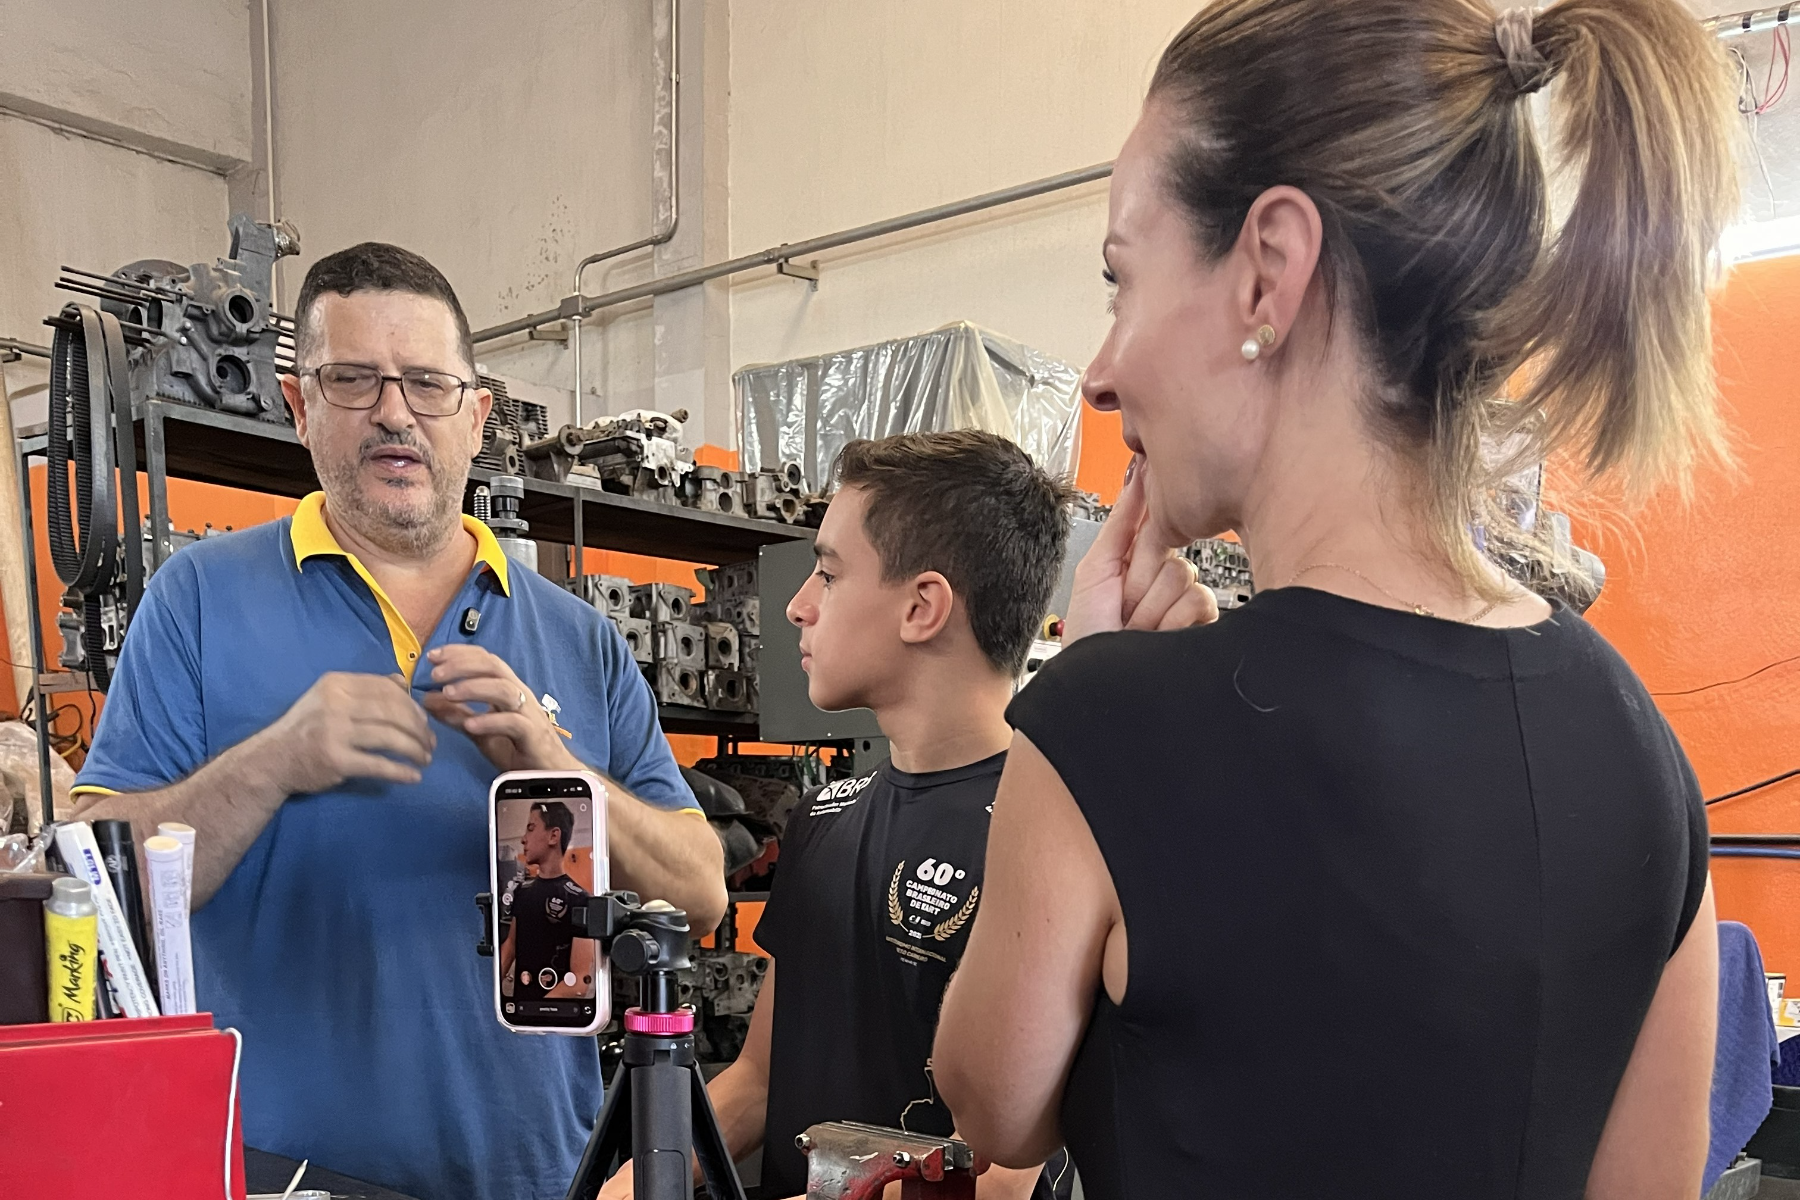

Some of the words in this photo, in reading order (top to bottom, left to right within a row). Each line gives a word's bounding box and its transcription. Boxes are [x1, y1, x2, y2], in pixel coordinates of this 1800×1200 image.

[906, 880, 958, 904] CAMPEONATO
[906, 889, 951, 910] BRASILEIRO
[910, 899, 922, 910] DE
[921, 902, 941, 915] KART
[65, 939, 86, 1004] Marking
[130, 964, 148, 999] COVERAGE
